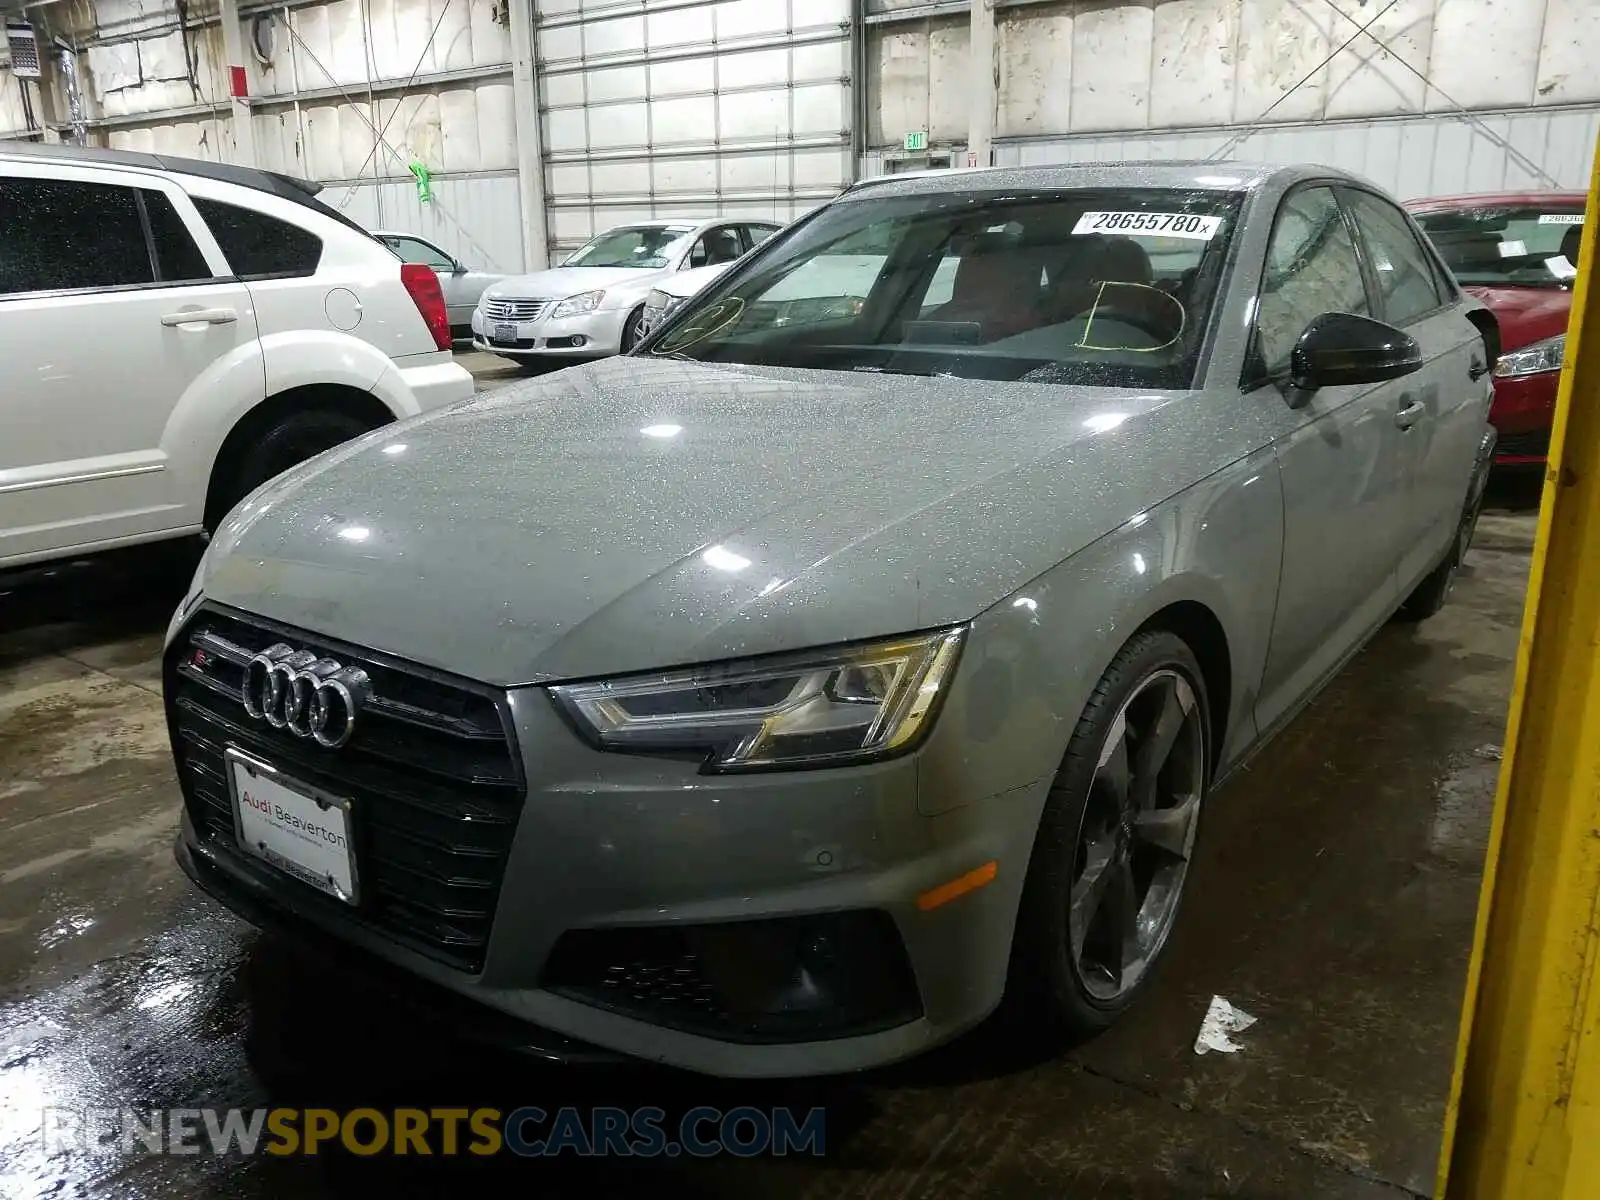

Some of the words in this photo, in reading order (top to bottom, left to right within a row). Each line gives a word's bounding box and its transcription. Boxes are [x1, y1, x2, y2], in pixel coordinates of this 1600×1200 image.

[906, 132, 925, 148] EXIT
[242, 791, 272, 816] Audi
[275, 804, 347, 849] Beaverton
